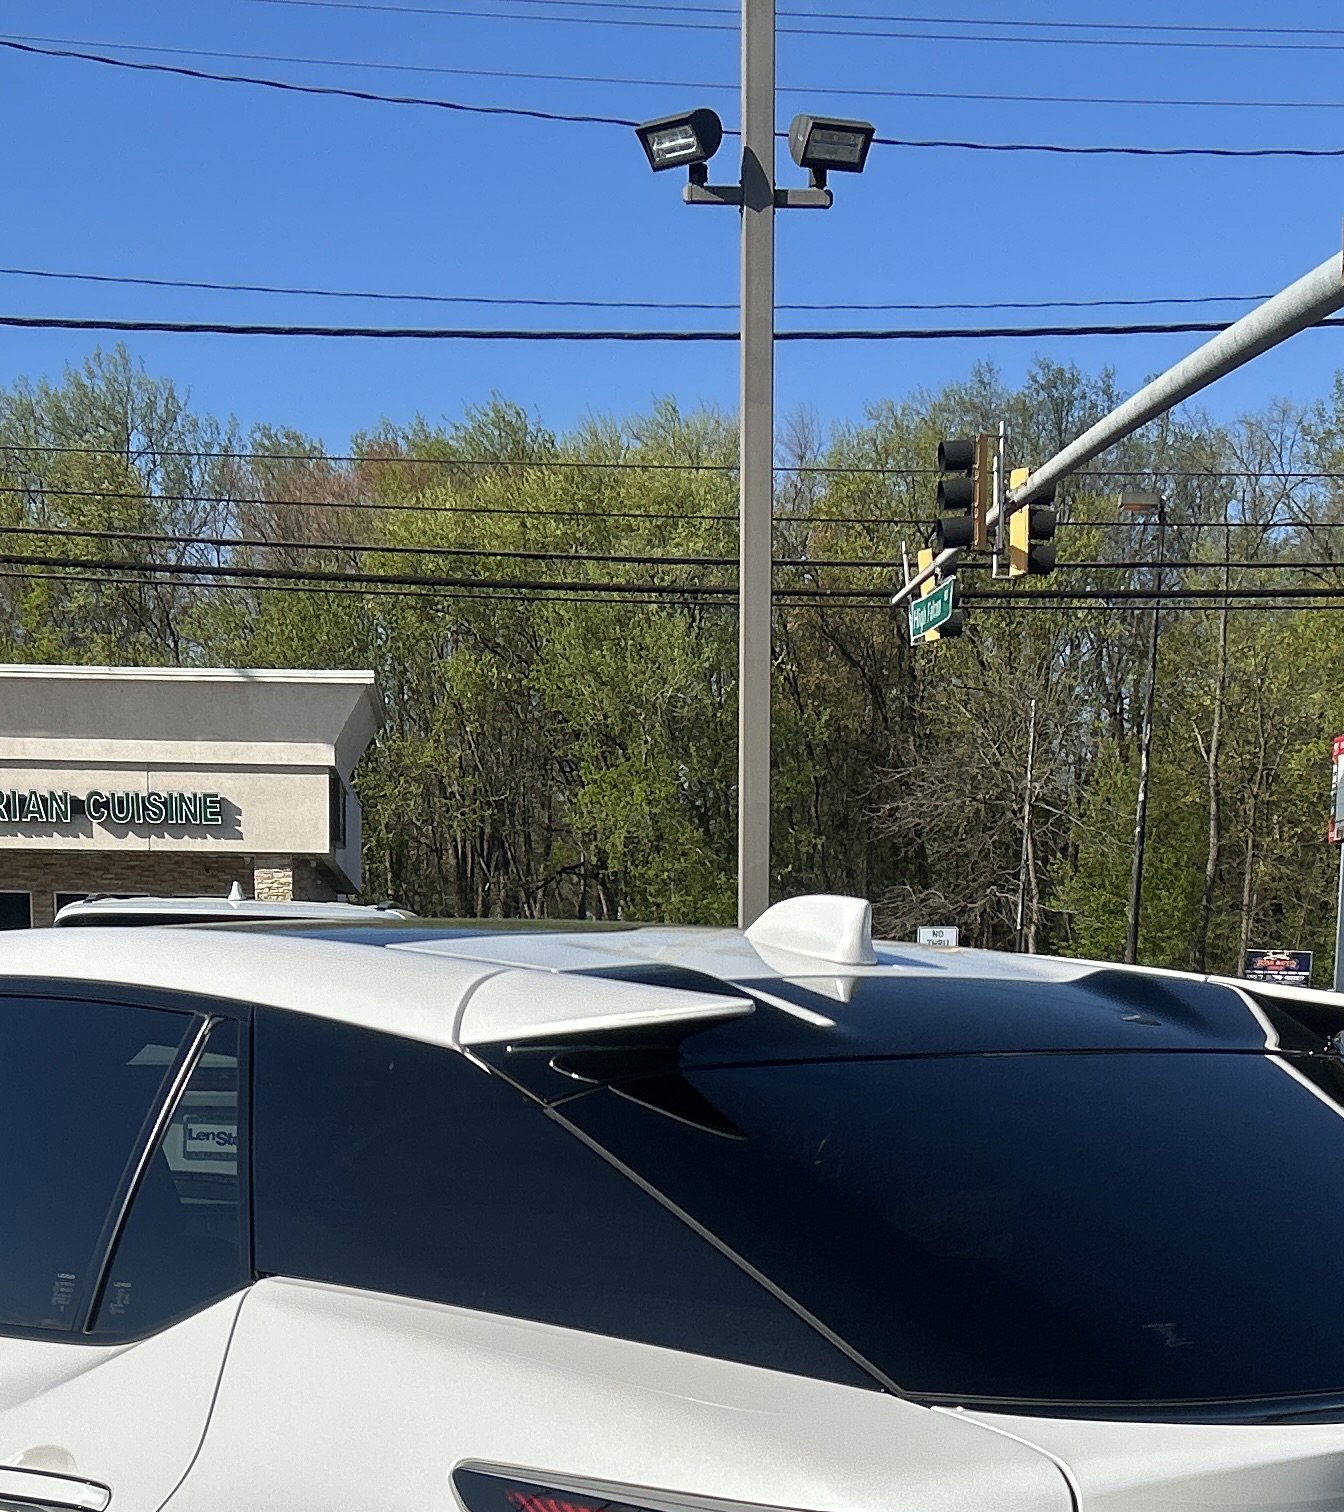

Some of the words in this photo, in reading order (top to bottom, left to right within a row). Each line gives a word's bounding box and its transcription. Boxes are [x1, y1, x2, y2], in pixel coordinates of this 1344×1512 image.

[84, 789, 223, 825] CUISINE
[932, 929, 945, 938] NO
[187, 1127, 238, 1147] LenSt
